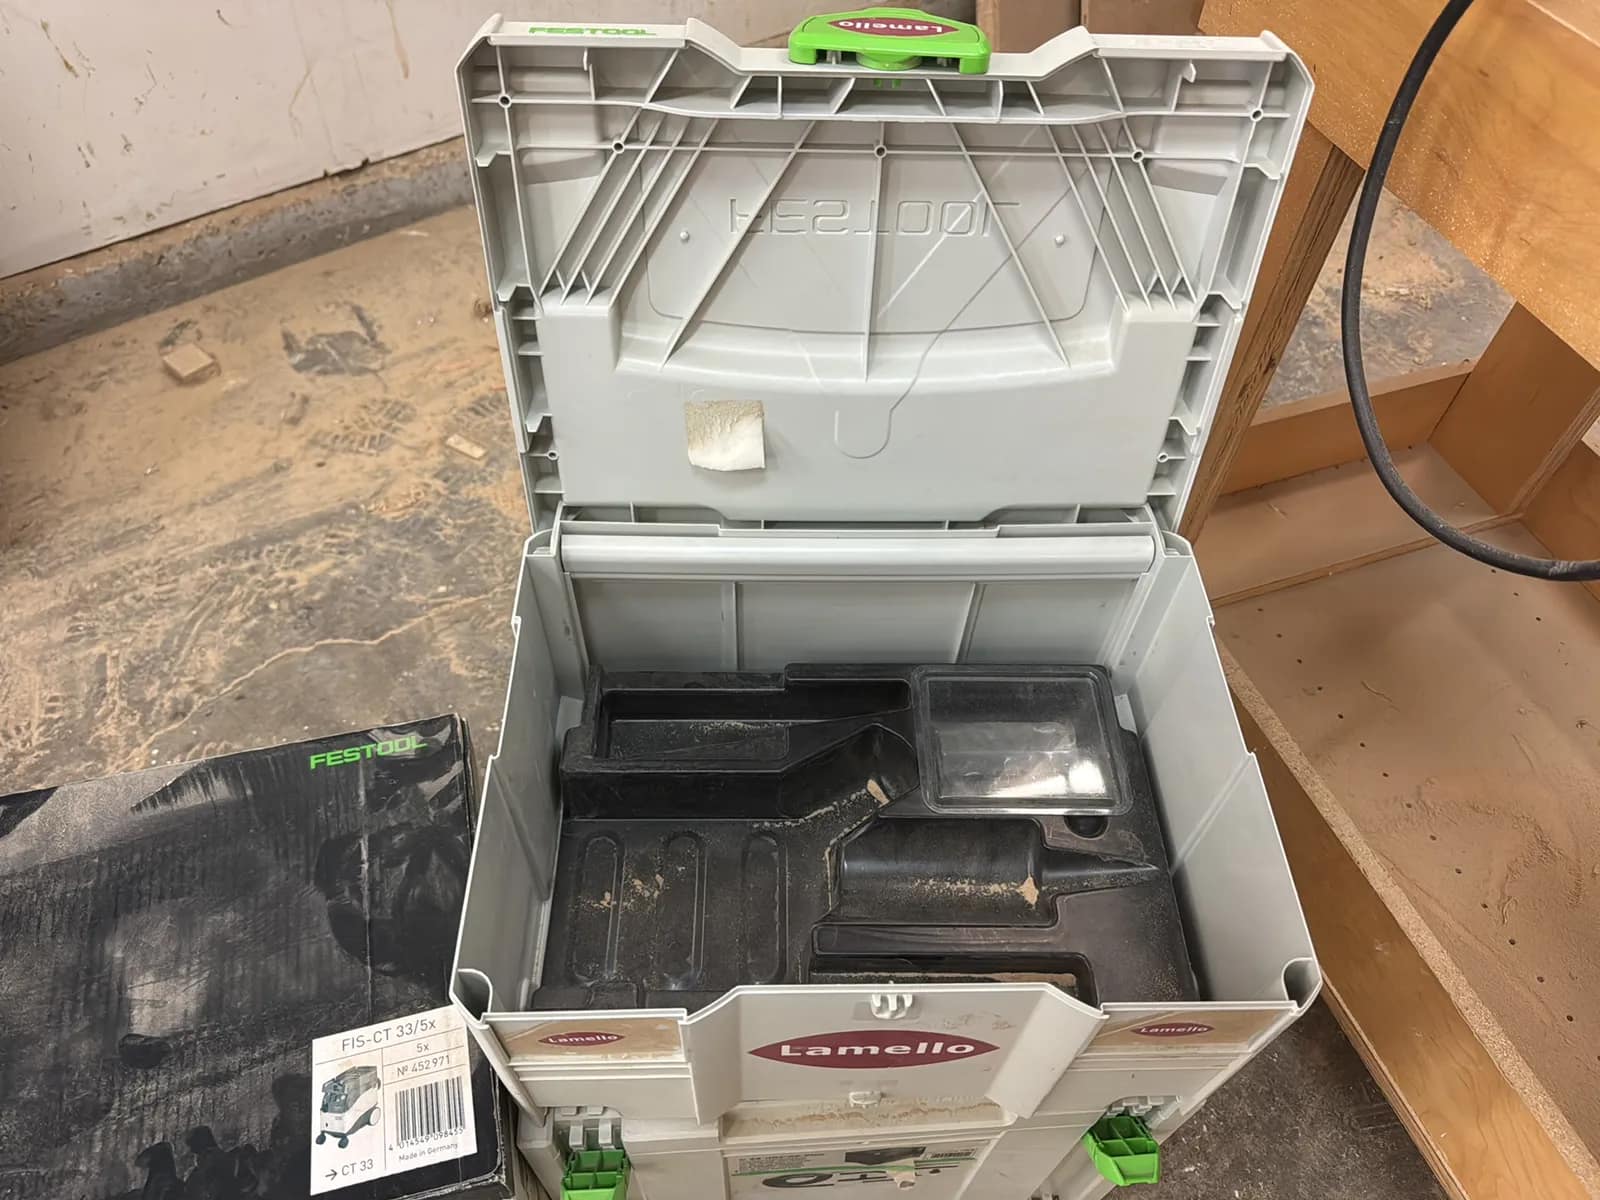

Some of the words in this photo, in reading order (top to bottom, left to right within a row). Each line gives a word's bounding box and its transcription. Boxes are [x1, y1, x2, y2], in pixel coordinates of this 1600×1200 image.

[528, 27, 657, 36] FESTOOL
[838, 21, 943, 33] Lamello
[309, 735, 428, 770] FESTOOL
[341, 1028, 392, 1051] FIS-CT
[396, 1019, 437, 1038] 33/5x
[548, 1035, 618, 1043] Lamello
[416, 1042, 430, 1053] 5x
[780, 1042, 976, 1056] Lamello
[398, 1152, 418, 1161] Made
[427, 1142, 458, 1156] Germany
[341, 1163, 357, 1176] CT
[360, 1159, 374, 1172] 33
